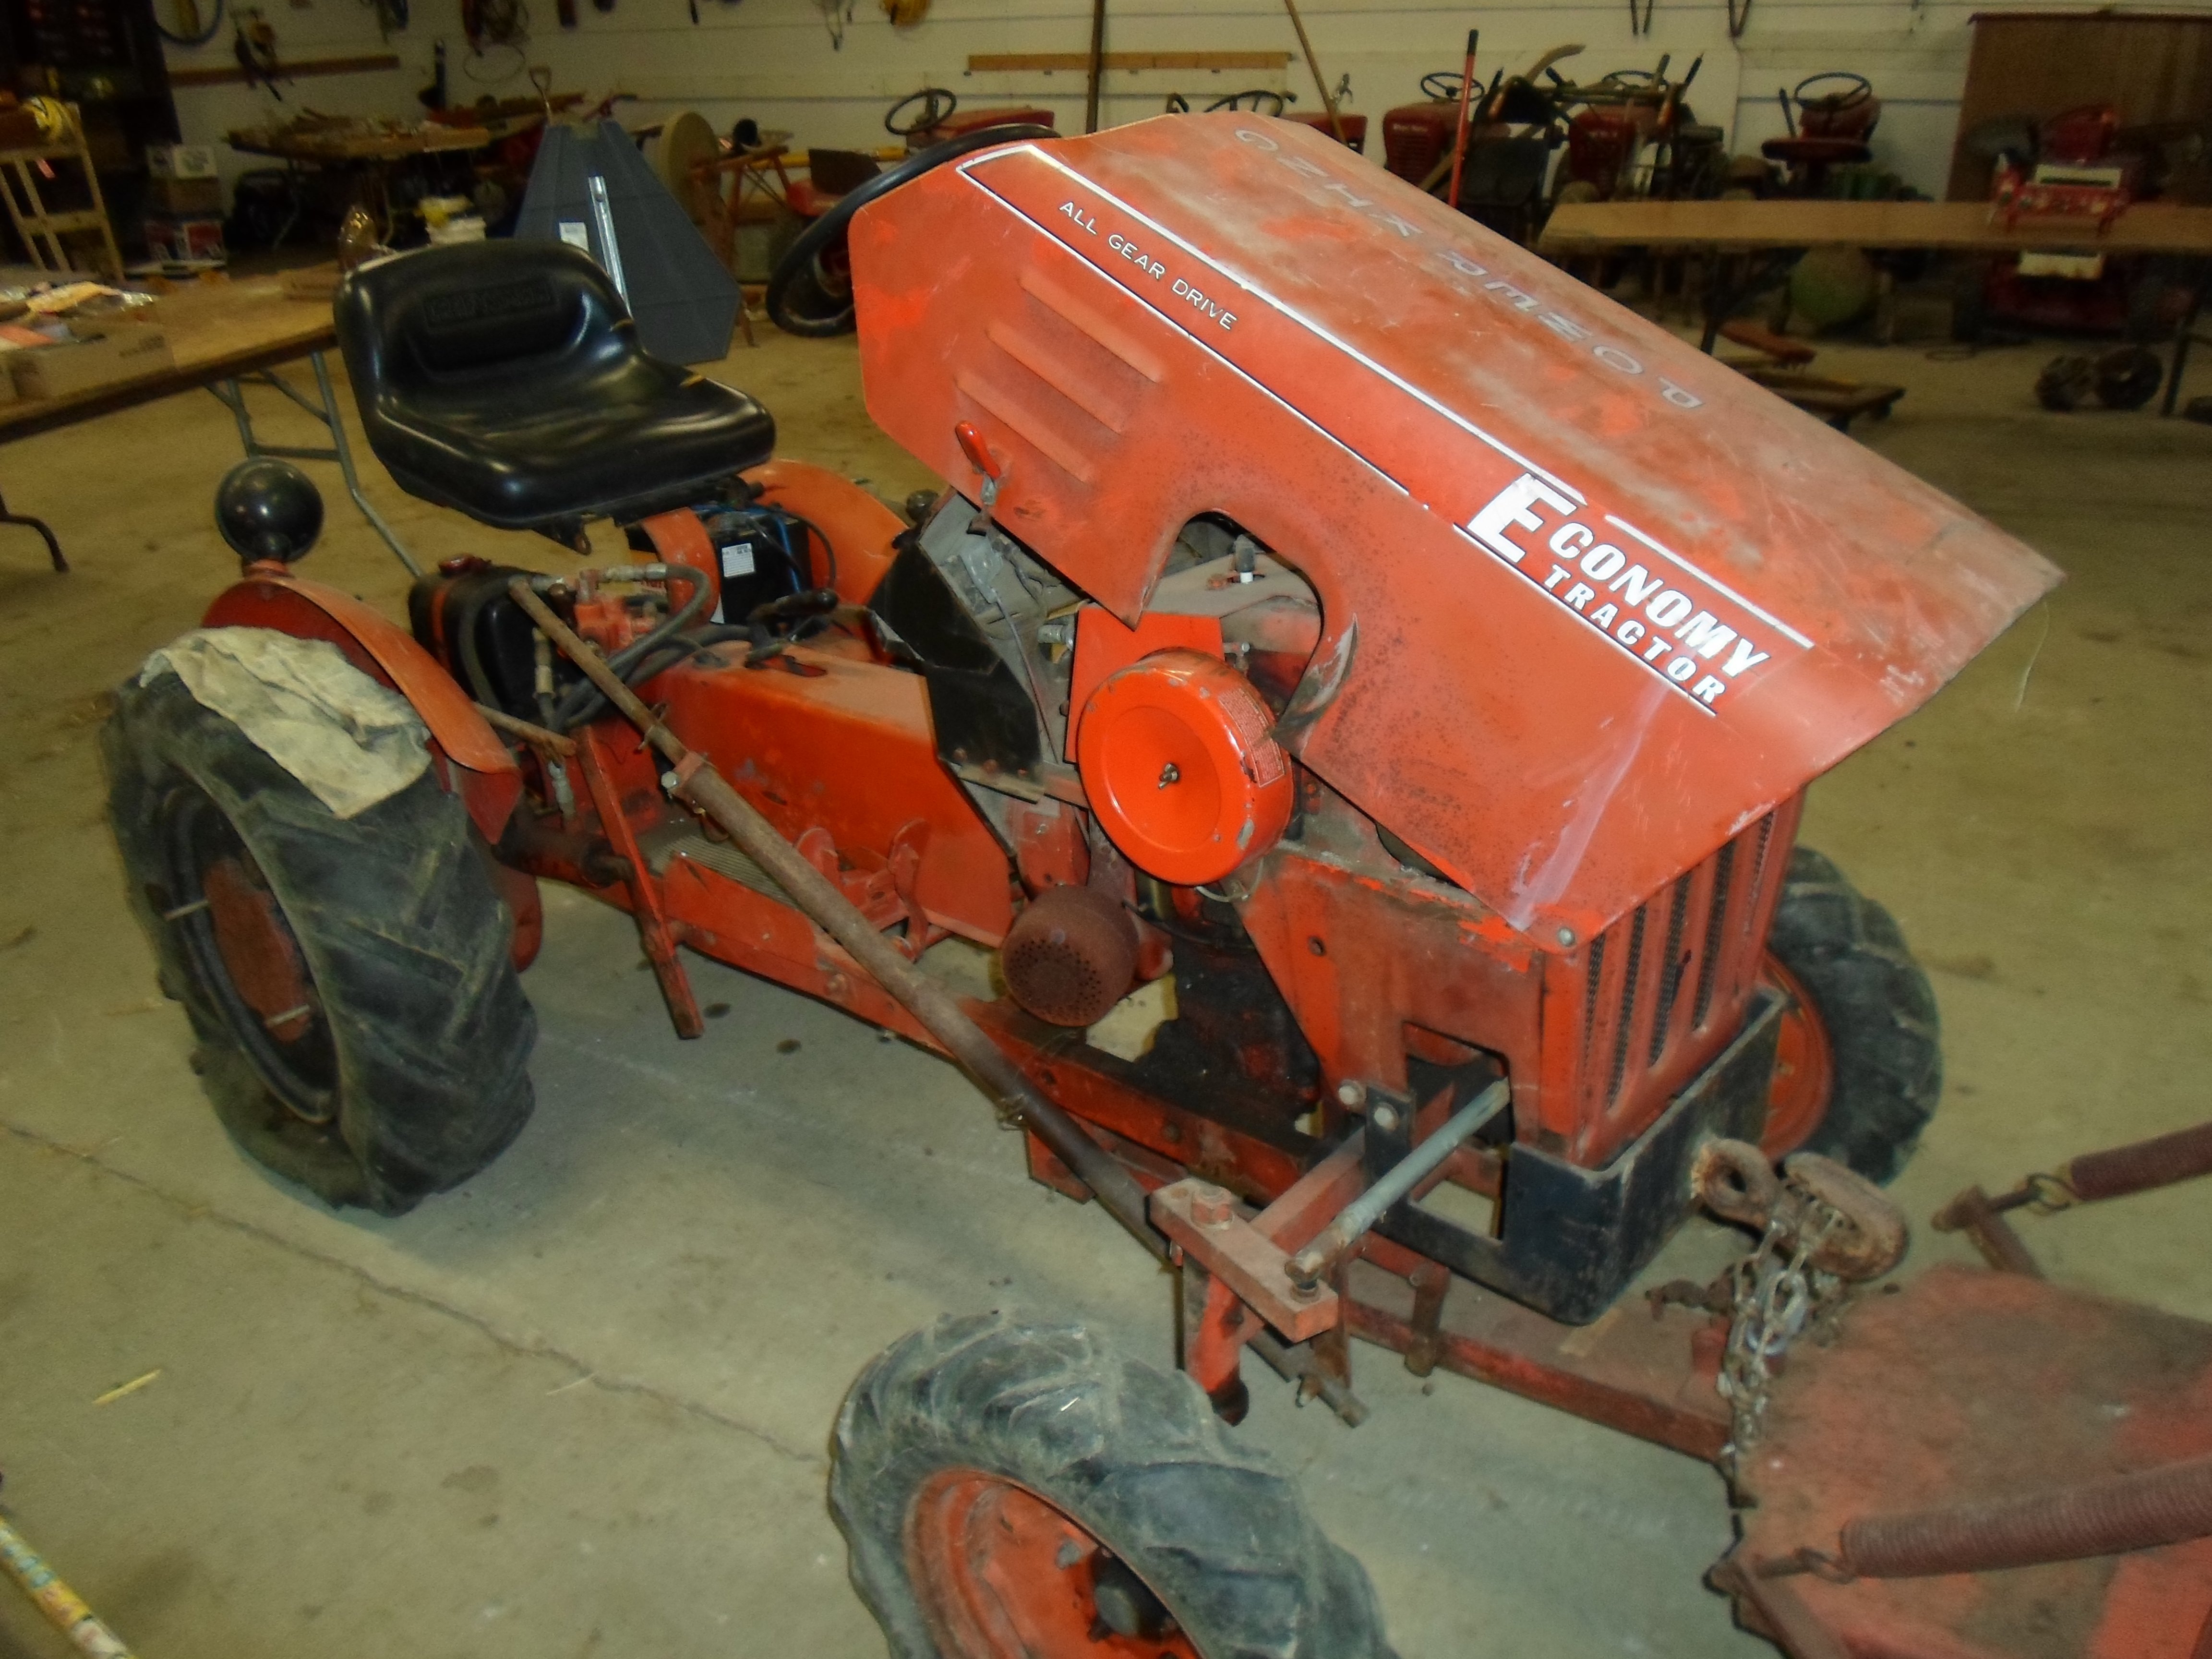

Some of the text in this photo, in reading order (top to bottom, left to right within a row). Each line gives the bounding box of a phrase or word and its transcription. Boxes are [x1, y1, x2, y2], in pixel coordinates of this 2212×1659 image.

[1058, 201, 1237, 330] ALL GEAR DRIVE
[1235, 129, 1704, 409] POWER KING
[1467, 472, 1771, 677] ECONOMY
[1542, 564, 1726, 704] TRACTOR
